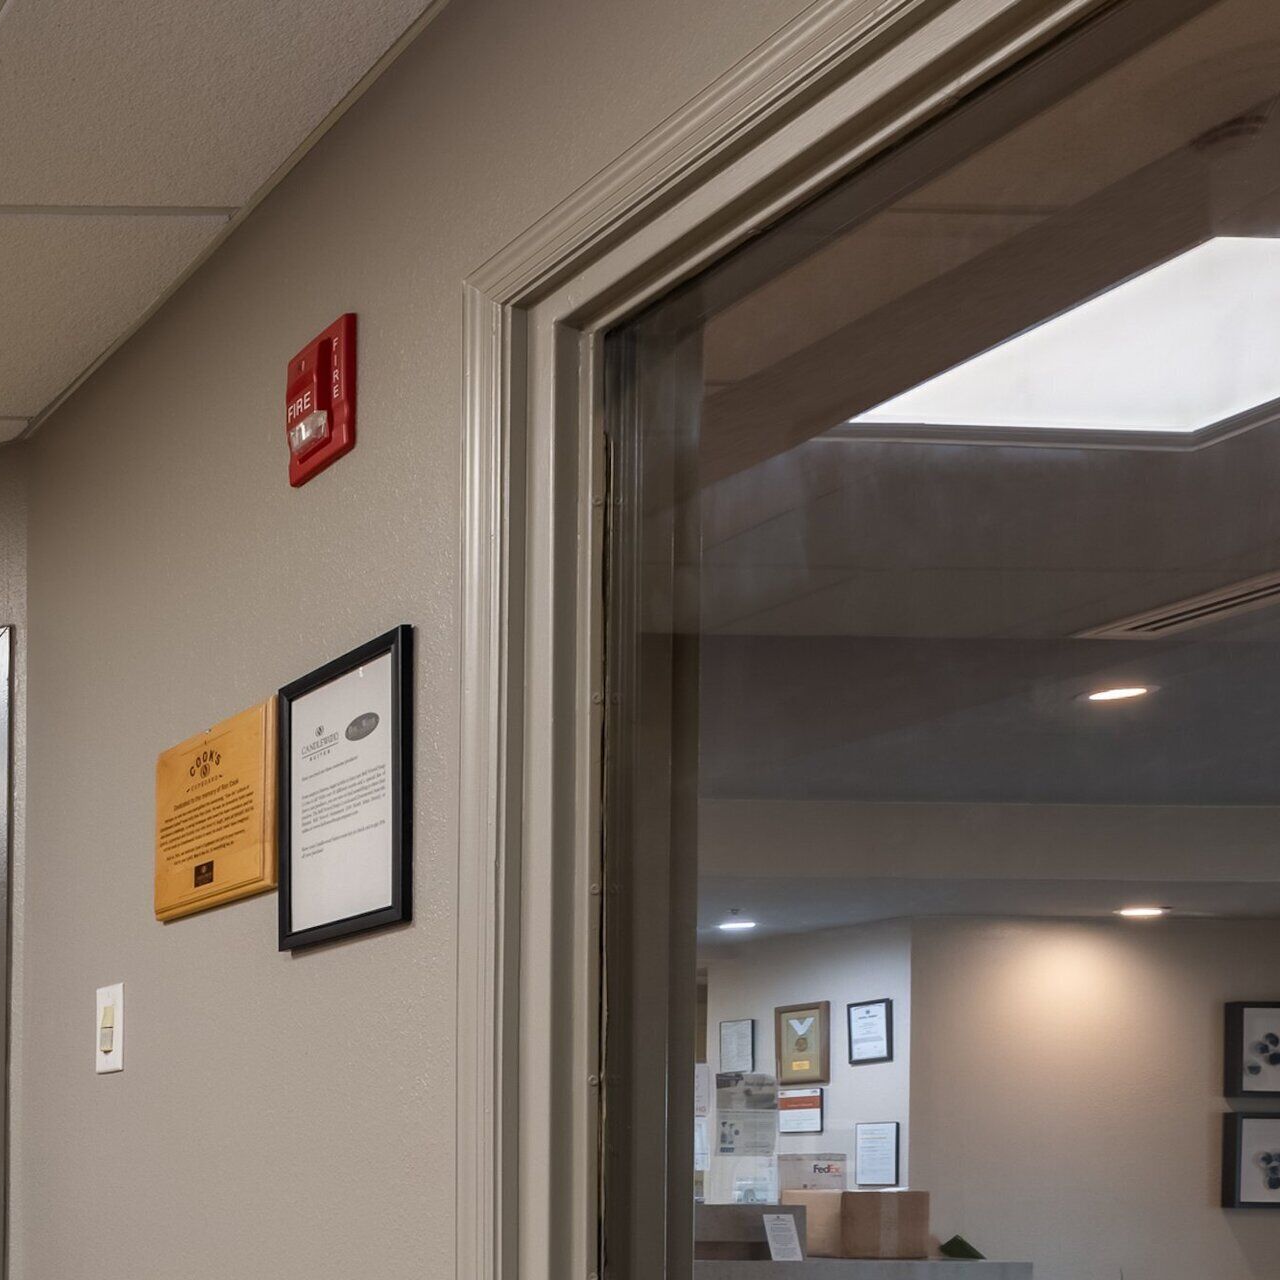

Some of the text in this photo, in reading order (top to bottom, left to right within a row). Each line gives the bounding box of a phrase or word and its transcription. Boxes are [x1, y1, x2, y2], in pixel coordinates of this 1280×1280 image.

[332, 337, 340, 399] FIRE
[288, 391, 311, 423] FIRE
[190, 750, 221, 777] COOK'S
